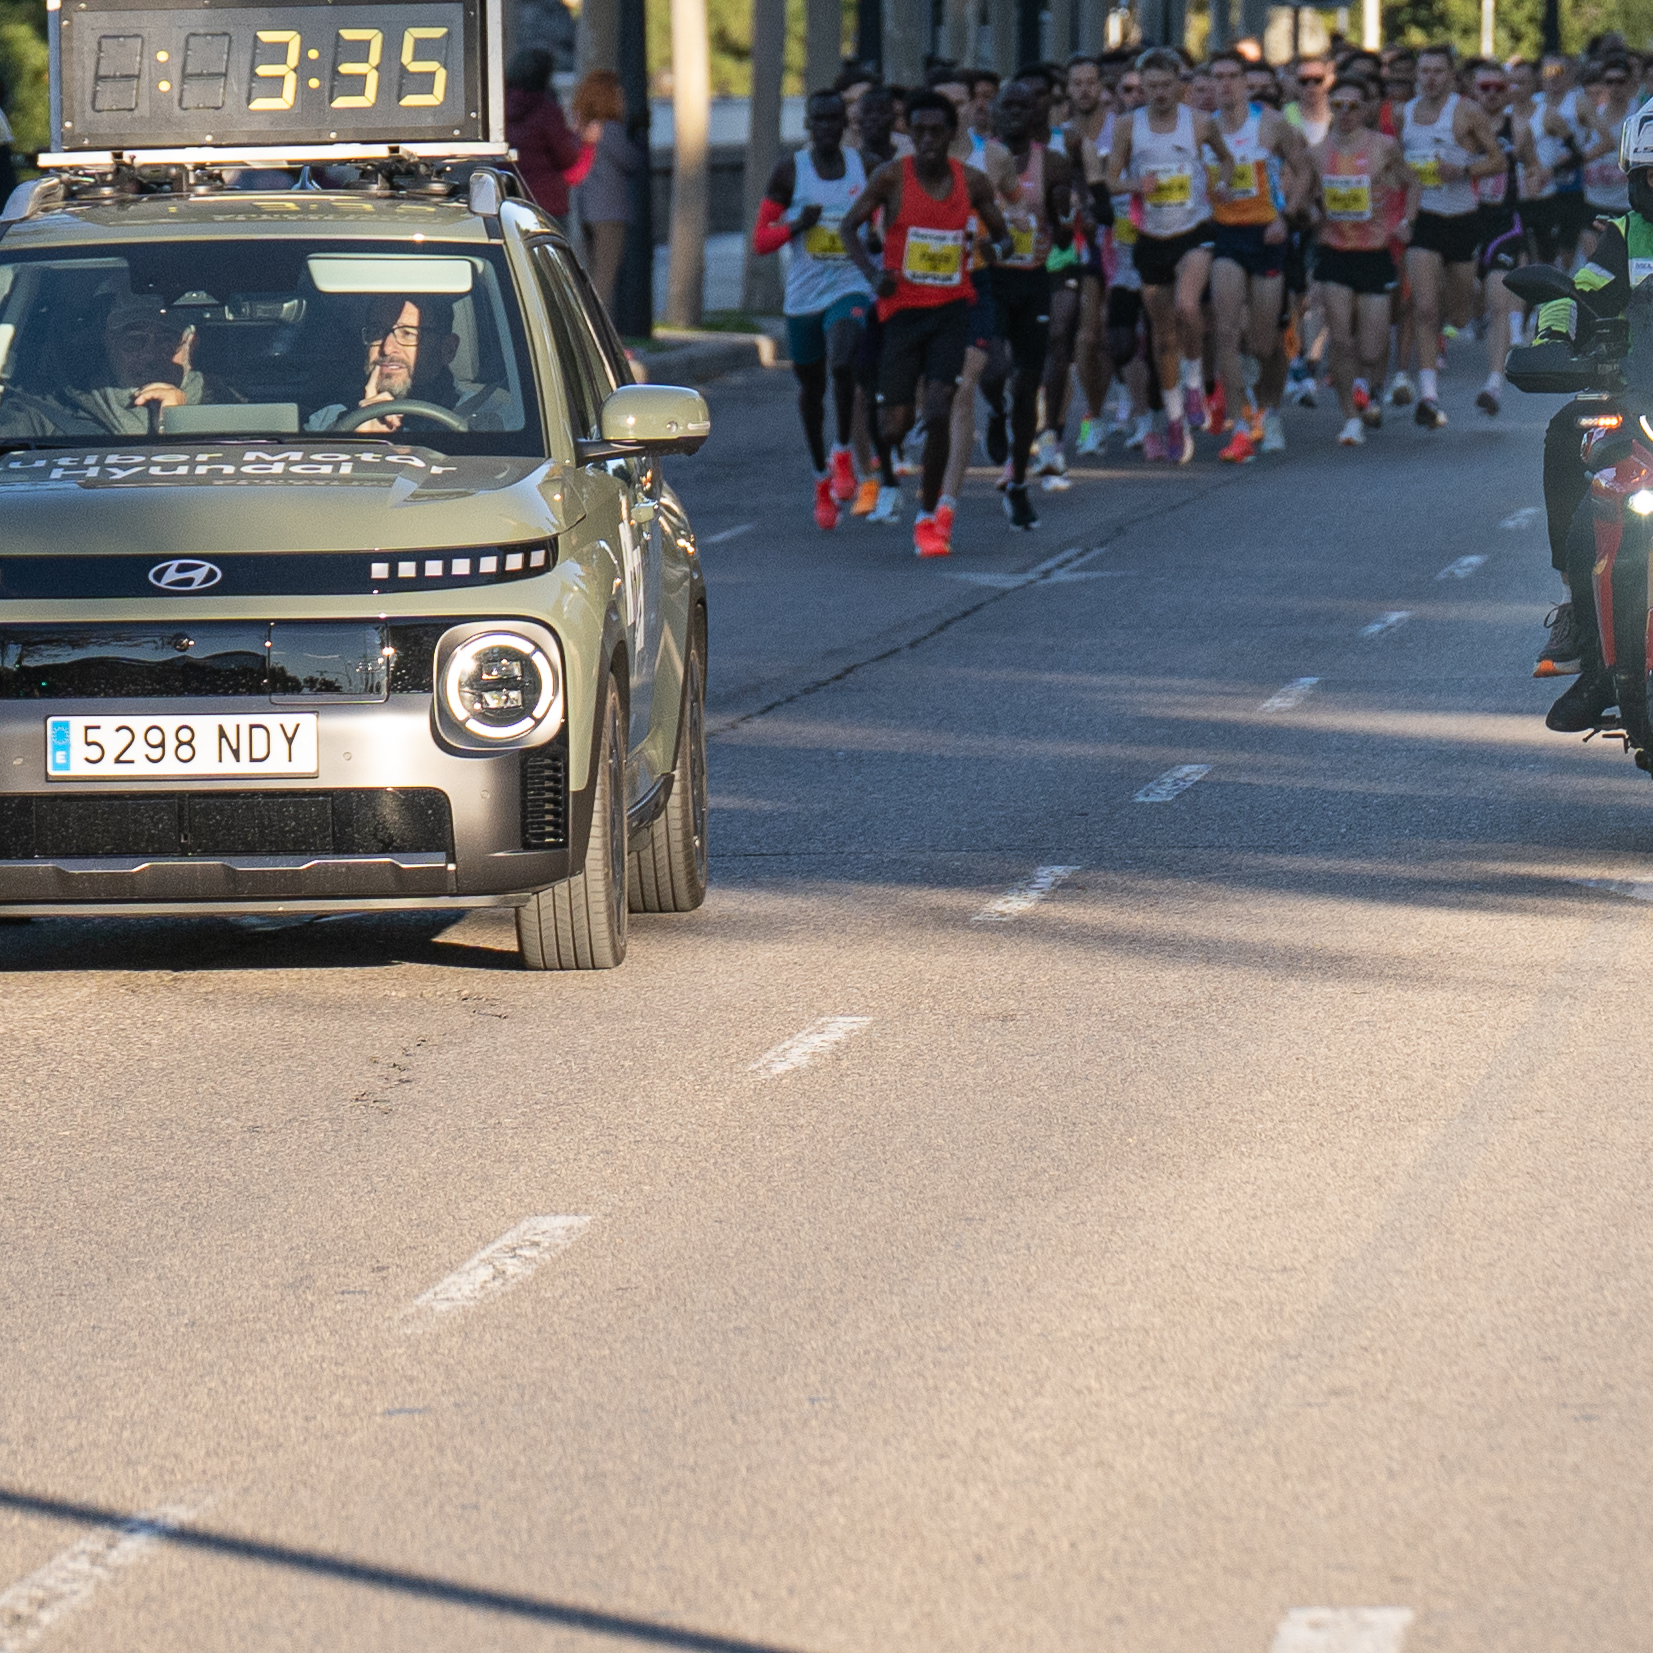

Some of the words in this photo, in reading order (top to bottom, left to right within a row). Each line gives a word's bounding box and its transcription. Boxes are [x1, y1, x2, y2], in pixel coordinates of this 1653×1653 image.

[49, 462, 353, 479] Hyundai
[83, 724, 196, 764] 5298
[218, 723, 300, 763] NDY
[55, 751, 67, 764] E
